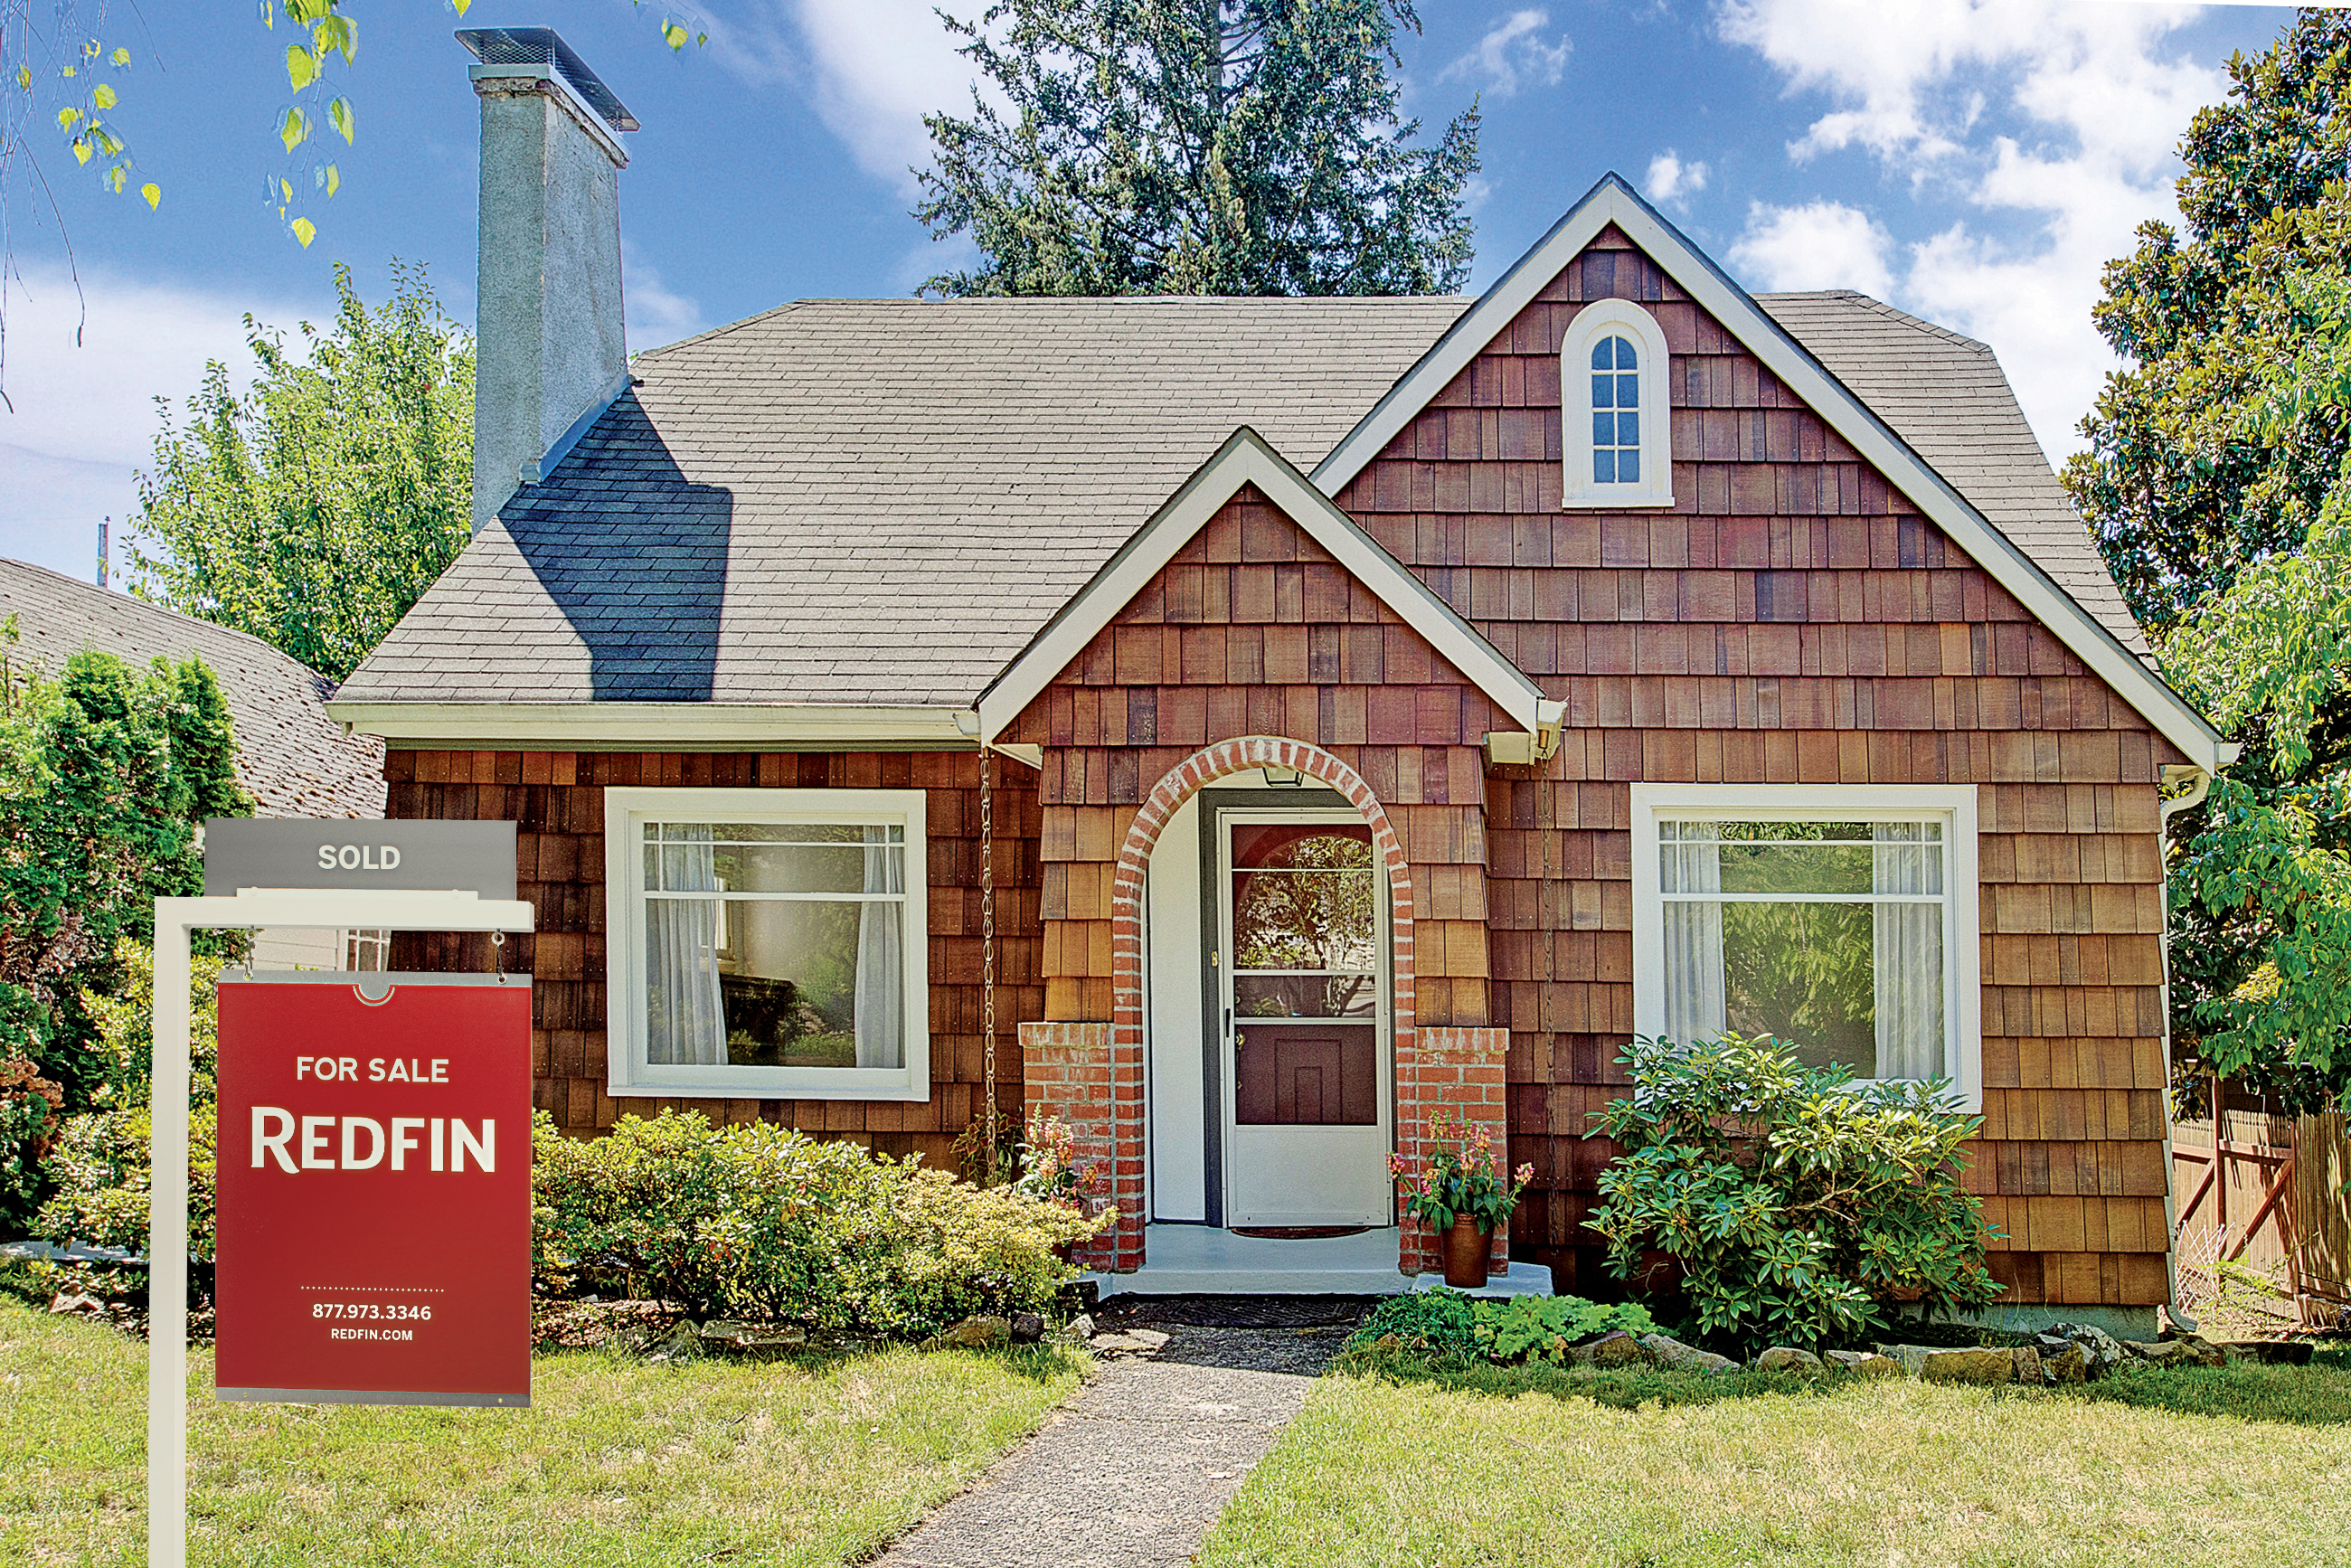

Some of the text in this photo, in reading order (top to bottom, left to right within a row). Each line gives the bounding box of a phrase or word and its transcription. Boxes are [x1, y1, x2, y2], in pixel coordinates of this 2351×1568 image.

[317, 845, 401, 870] SOLD
[297, 1056, 449, 1083] FOR SALE
[250, 1106, 496, 1174] REDFIN
[312, 1303, 432, 1321] 877.973.3346
[331, 1327, 413, 1341] REDFIN.COM
